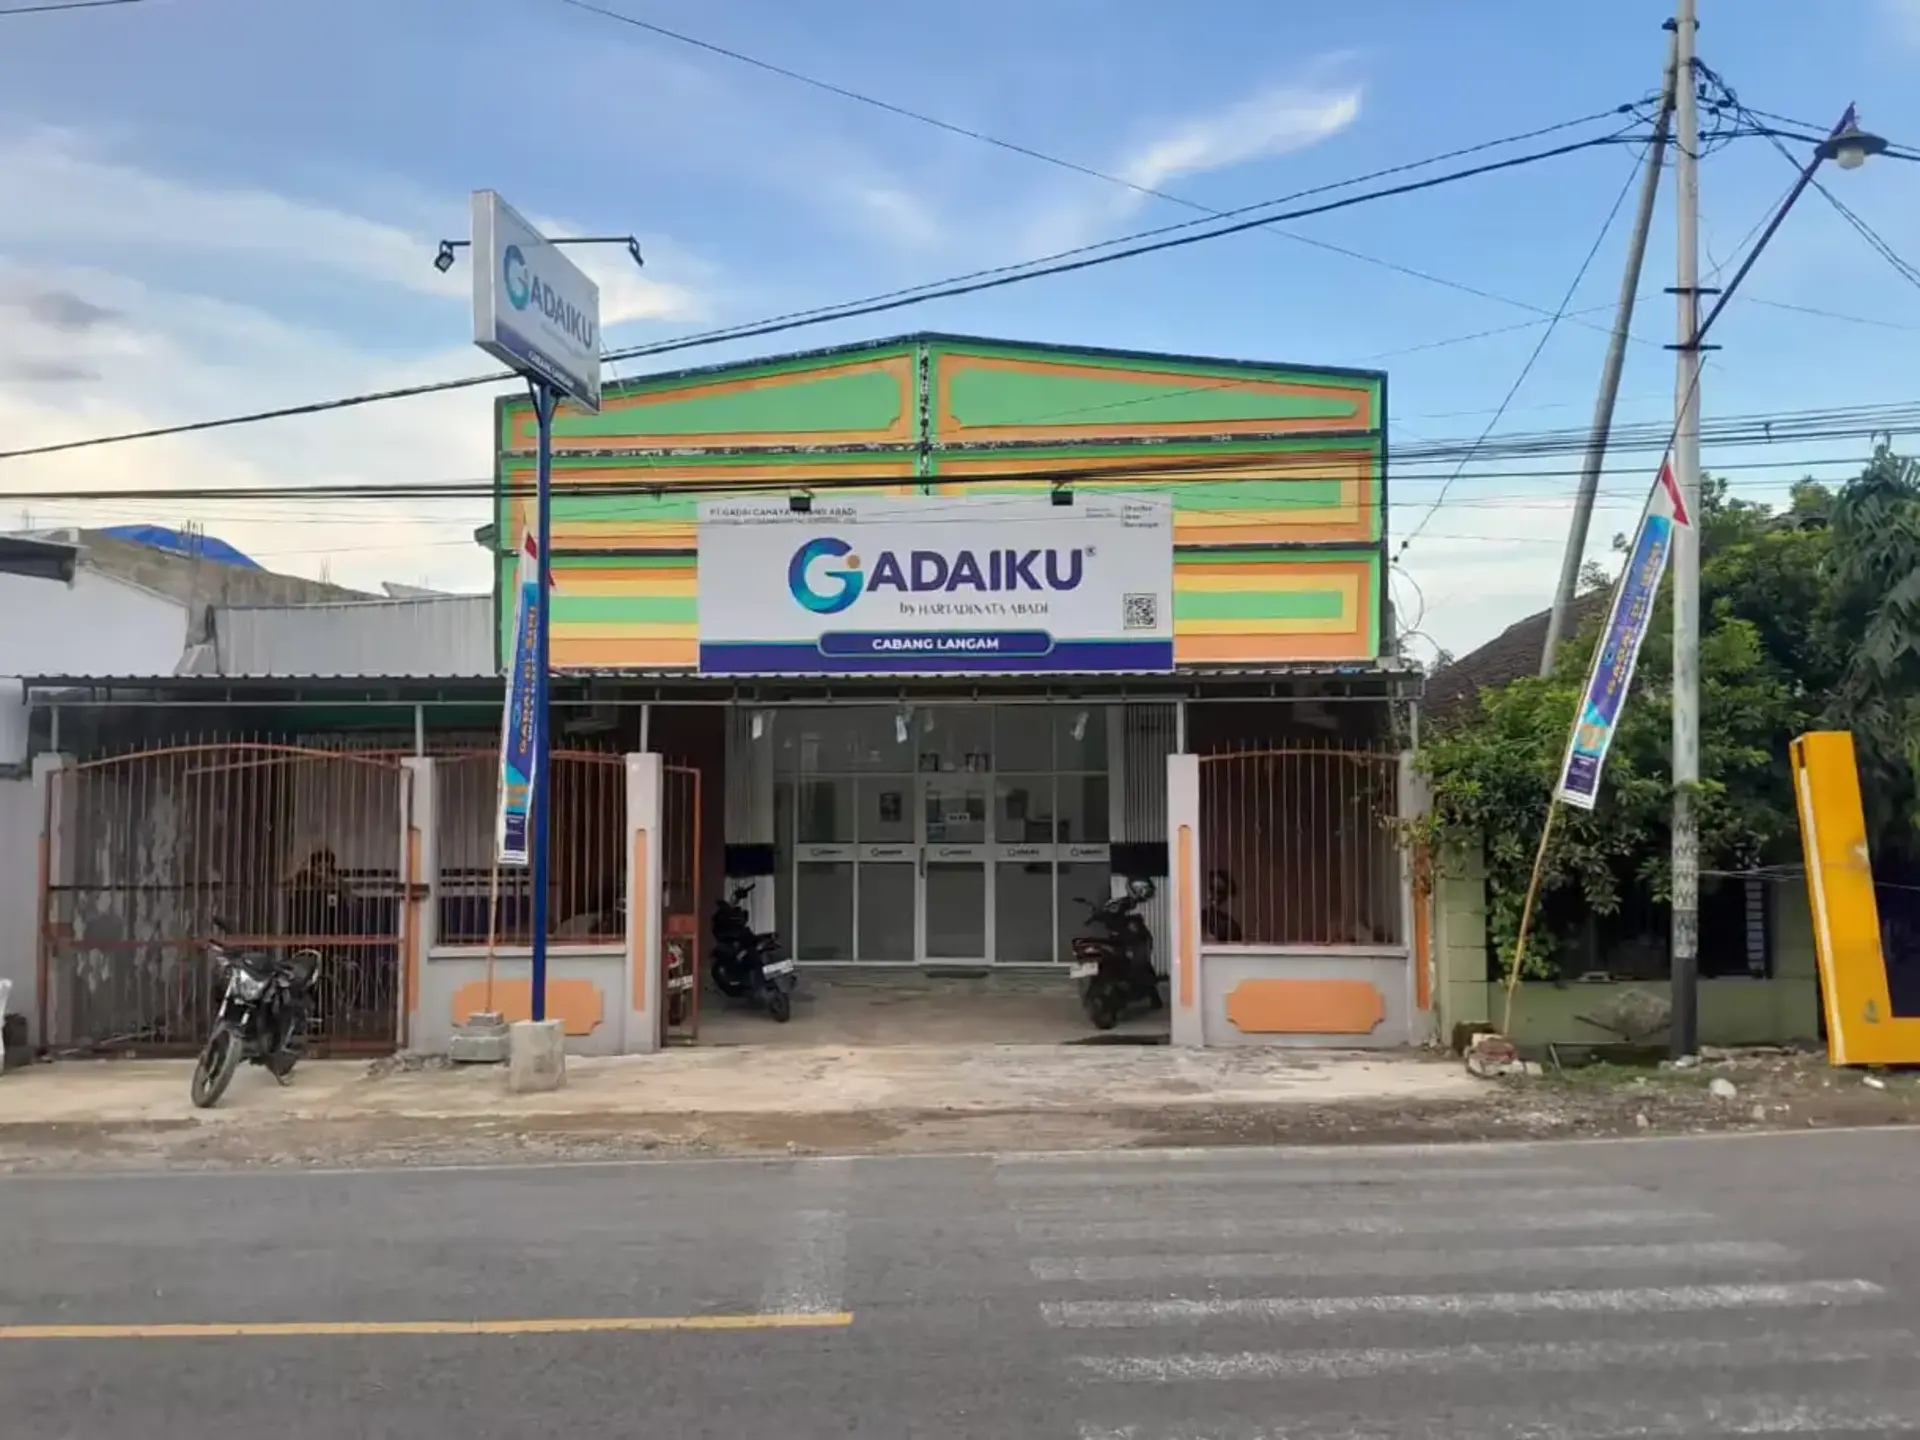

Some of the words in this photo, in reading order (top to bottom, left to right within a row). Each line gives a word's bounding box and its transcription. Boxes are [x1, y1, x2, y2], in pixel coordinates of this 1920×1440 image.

[504, 245, 592, 349] GADAIKU
[788, 537, 1083, 615] GADAIKU
[899, 601, 915, 616] by
[918, 602, 1006, 615] HARTADINATA
[1009, 602, 1049, 616] ABADI
[872, 638, 933, 650] CABANG
[937, 637, 999, 650] LANGAM
